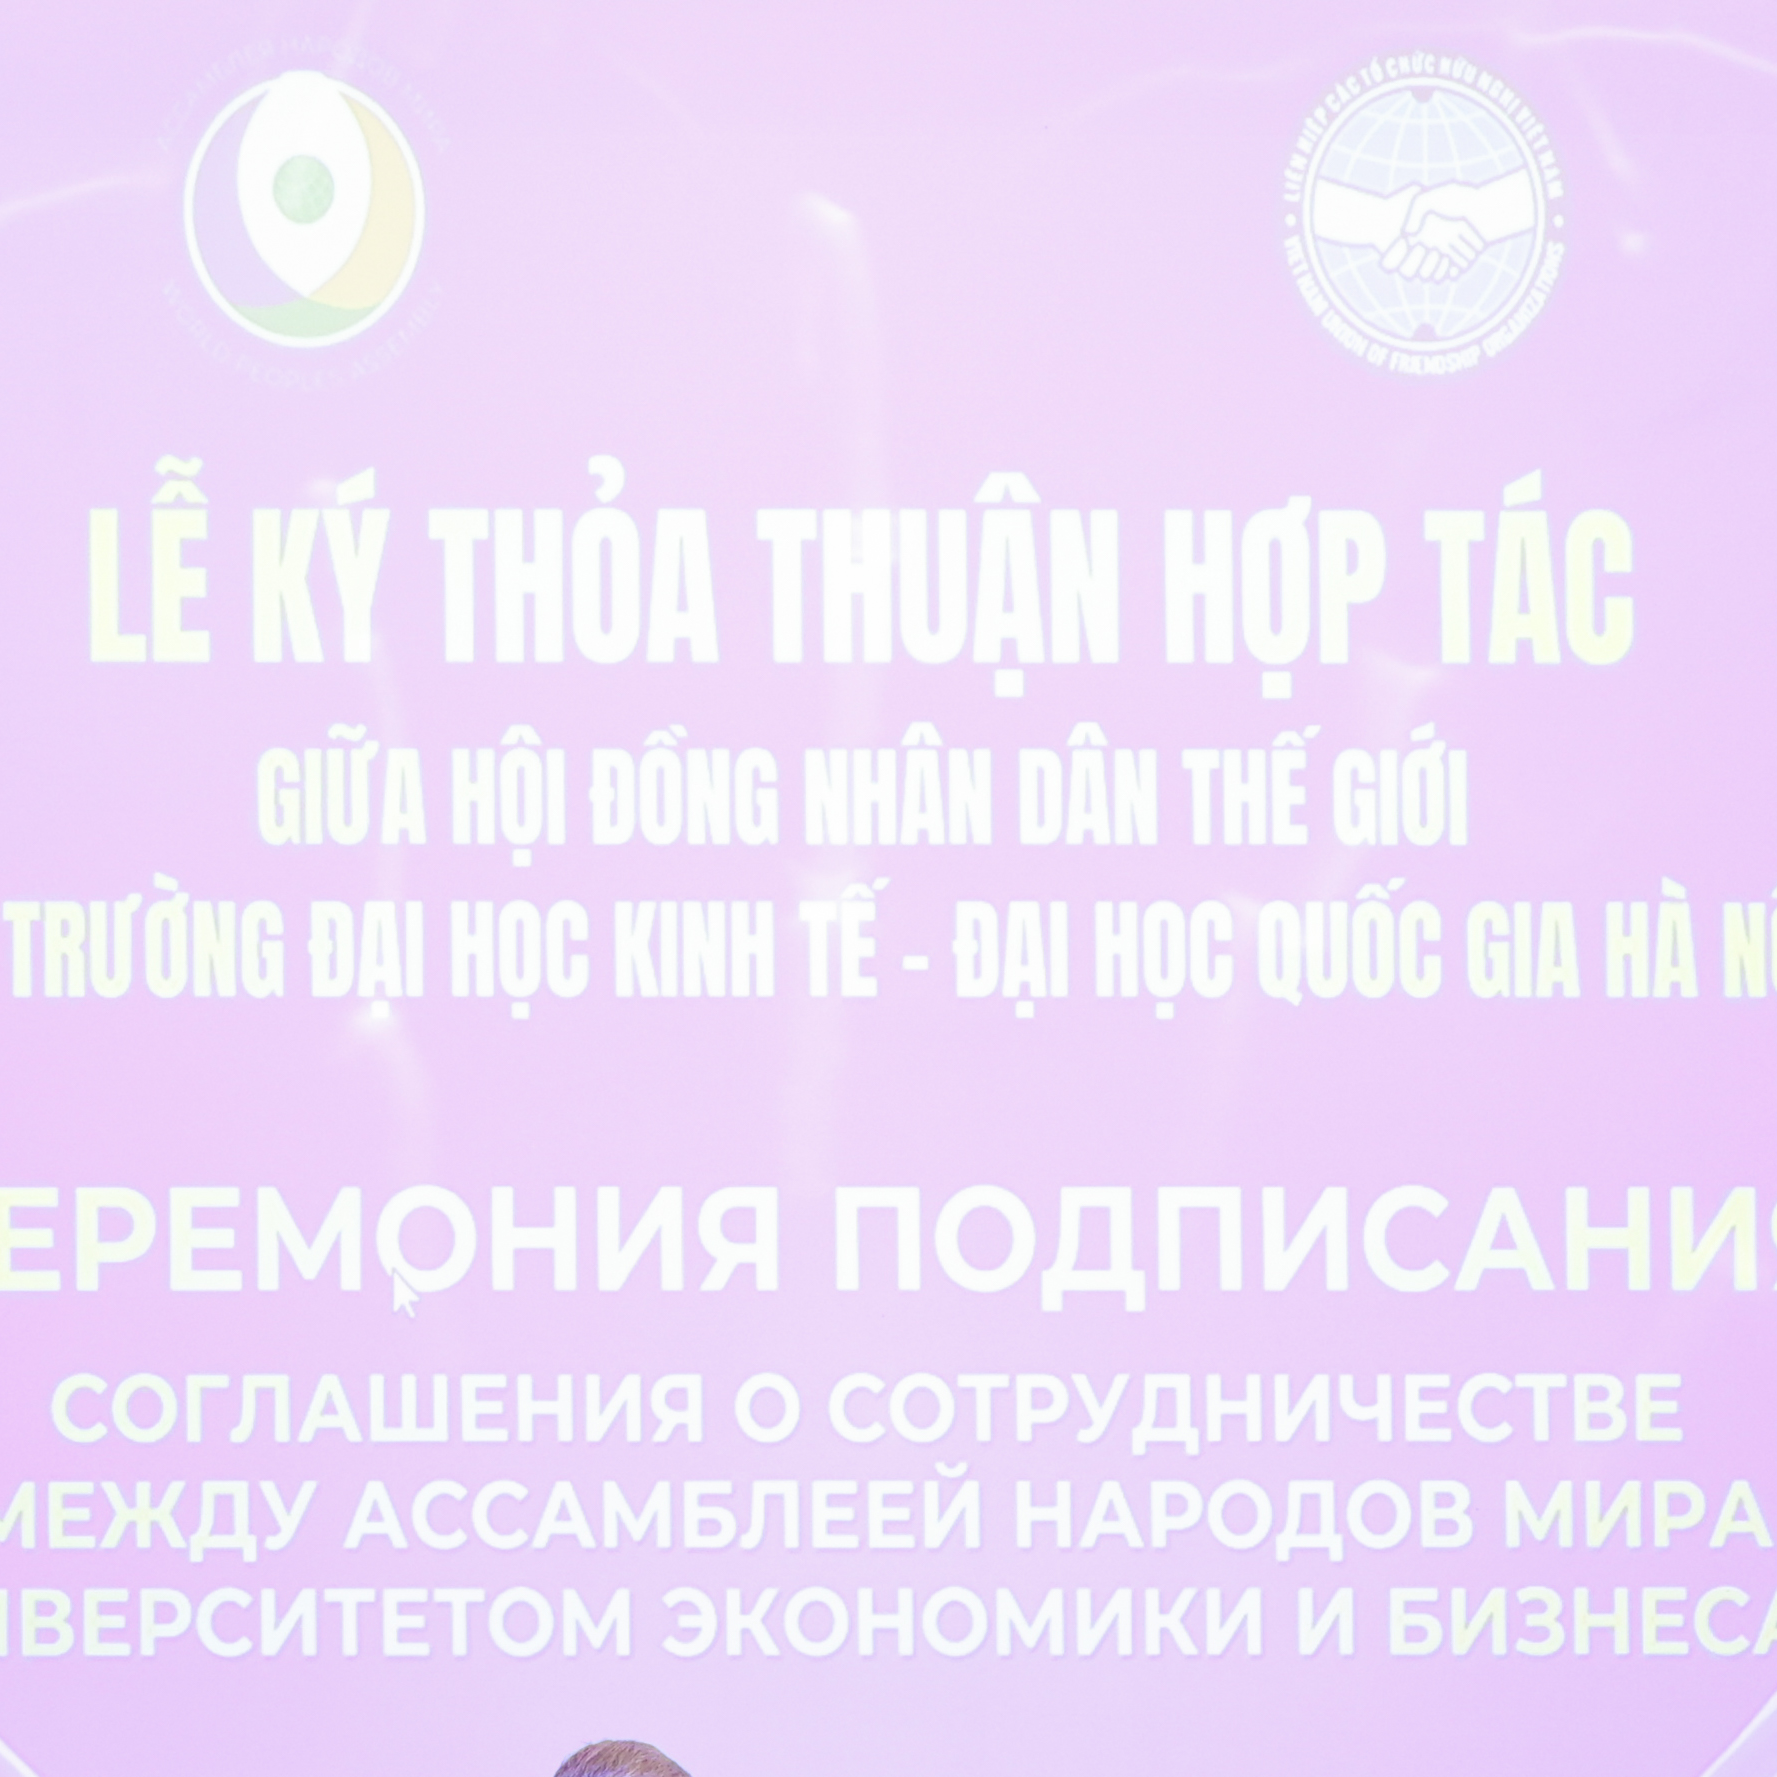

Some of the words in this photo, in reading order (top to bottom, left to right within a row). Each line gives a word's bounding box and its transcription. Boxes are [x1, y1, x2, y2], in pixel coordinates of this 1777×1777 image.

[1539, 150, 1564, 199] NAM
[88, 454, 211, 664] LỄ
[251, 467, 391, 663] KÝ
[427, 454, 720, 664] THỎA
[755, 471, 1120, 696] THUẬN
[1163, 495, 1387, 699] HỢP
[1423, 468, 1635, 665] TÁC
[256, 723, 427, 846] GIỮA
[452, 725, 566, 867] HỘI
[589, 724, 778, 845] ĐỒNG
[805, 722, 992, 845] NHÂN
[1020, 722, 1158, 845] DÂN
[1182, 725, 1321, 846] THẾ
[1333, 722, 1468, 846] GIỚI
[1, 872, 285, 999] TRƯỜNG
[307, 899, 424, 1020] ĐẠI
[450, 900, 590, 1020] HỌC
[614, 900, 775, 998] KINH
[798, 877, 891, 998] TẾ
[902, 955, 929, 970] -
[952, 900, 1069, 1019] ĐẠI
[1094, 900, 1234, 1020] HỌC
[1257, 877, 1443, 1007] QUỐC
[1465, 900, 1581, 999] GIA
[1605, 876, 1699, 999] HÀ
[50, 1372, 703, 1443] СОГЛАШЕНИЯ
[735, 1372, 800, 1442] О
[828, 1372, 1683, 1457] СОТРУДНИЧЕСТВЕ
[343, 1461, 980, 1549] АССАМБЛЕЕЙ
[1016, 1479, 1473, 1562] НАРОДОВ
[1504, 1479, 1774, 1548] МИРА
[662, 1586, 1262, 1656] ЭКОНОМИКИ
[1298, 1587, 1354, 1656] И
